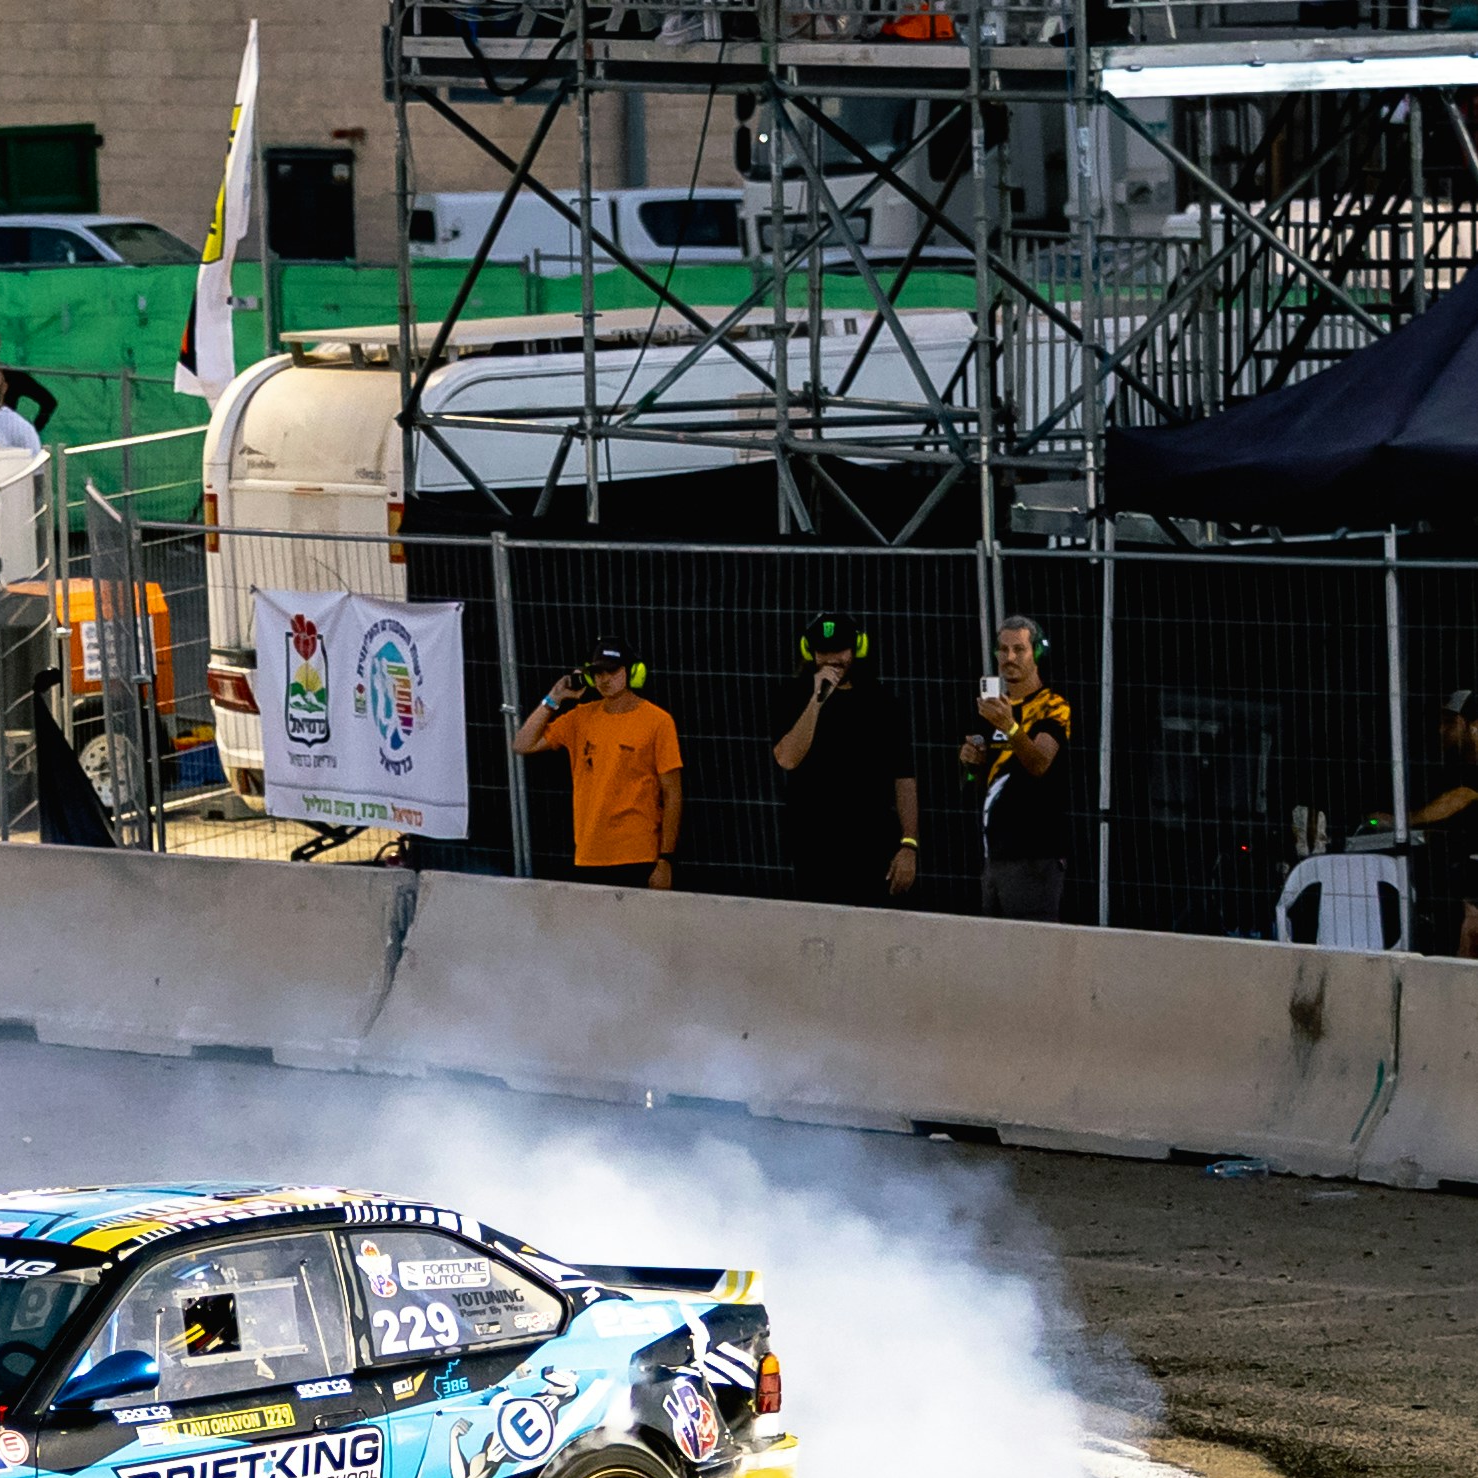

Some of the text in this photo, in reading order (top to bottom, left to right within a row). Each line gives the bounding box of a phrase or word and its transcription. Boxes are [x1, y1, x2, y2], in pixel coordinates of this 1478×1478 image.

[422, 1261, 487, 1275] FORTUNE
[425, 1274, 461, 1286] AUTO
[452, 1288, 525, 1308] YOTUNING
[489, 1305, 502, 1316] By
[372, 1302, 460, 1355] 229
[441, 1376, 469, 1394] 386
[210, 1412, 261, 1435] OHAYON
[266, 1406, 291, 1426] 229
